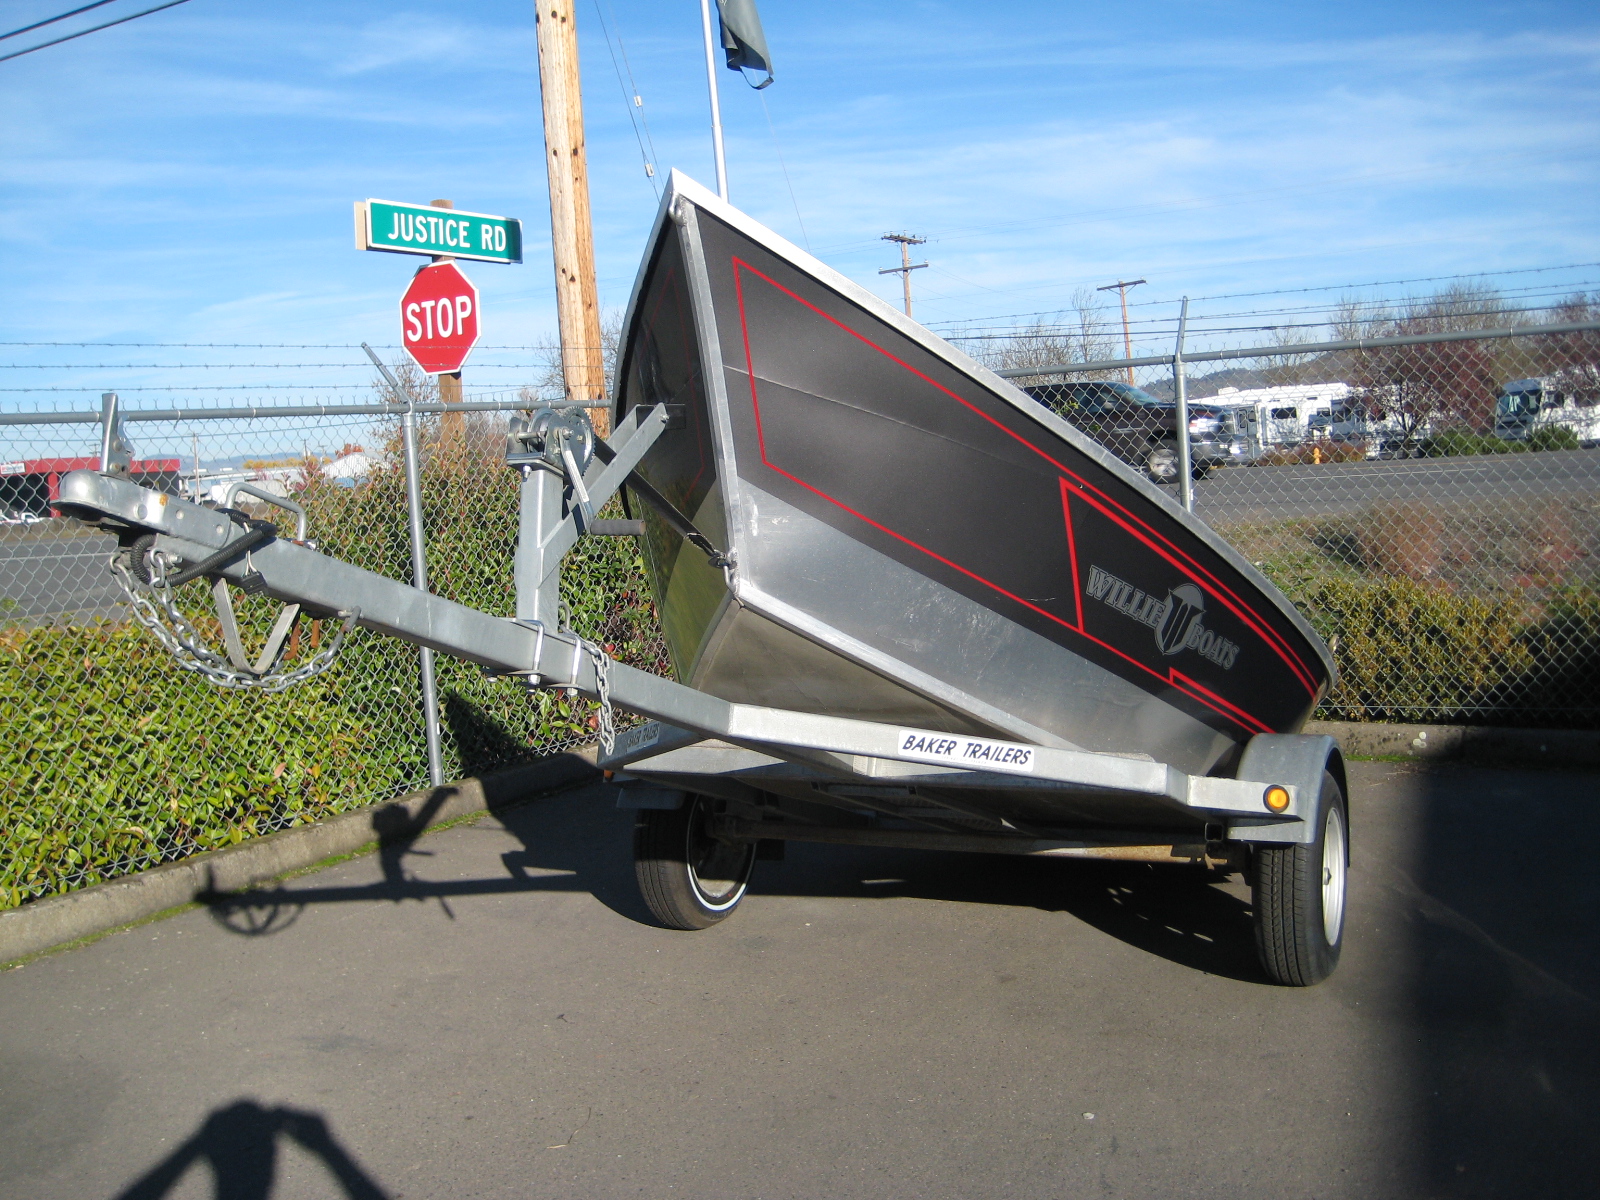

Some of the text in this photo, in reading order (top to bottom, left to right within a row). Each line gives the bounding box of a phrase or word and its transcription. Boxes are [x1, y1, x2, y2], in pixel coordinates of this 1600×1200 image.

[387, 212, 507, 252] JUSTICE RD
[406, 295, 472, 342] STOP
[1085, 564, 1167, 629] WILLIE
[1186, 622, 1240, 670] BOATS
[902, 734, 958, 756] BAKER
[963, 742, 1032, 765] TRAILERS
